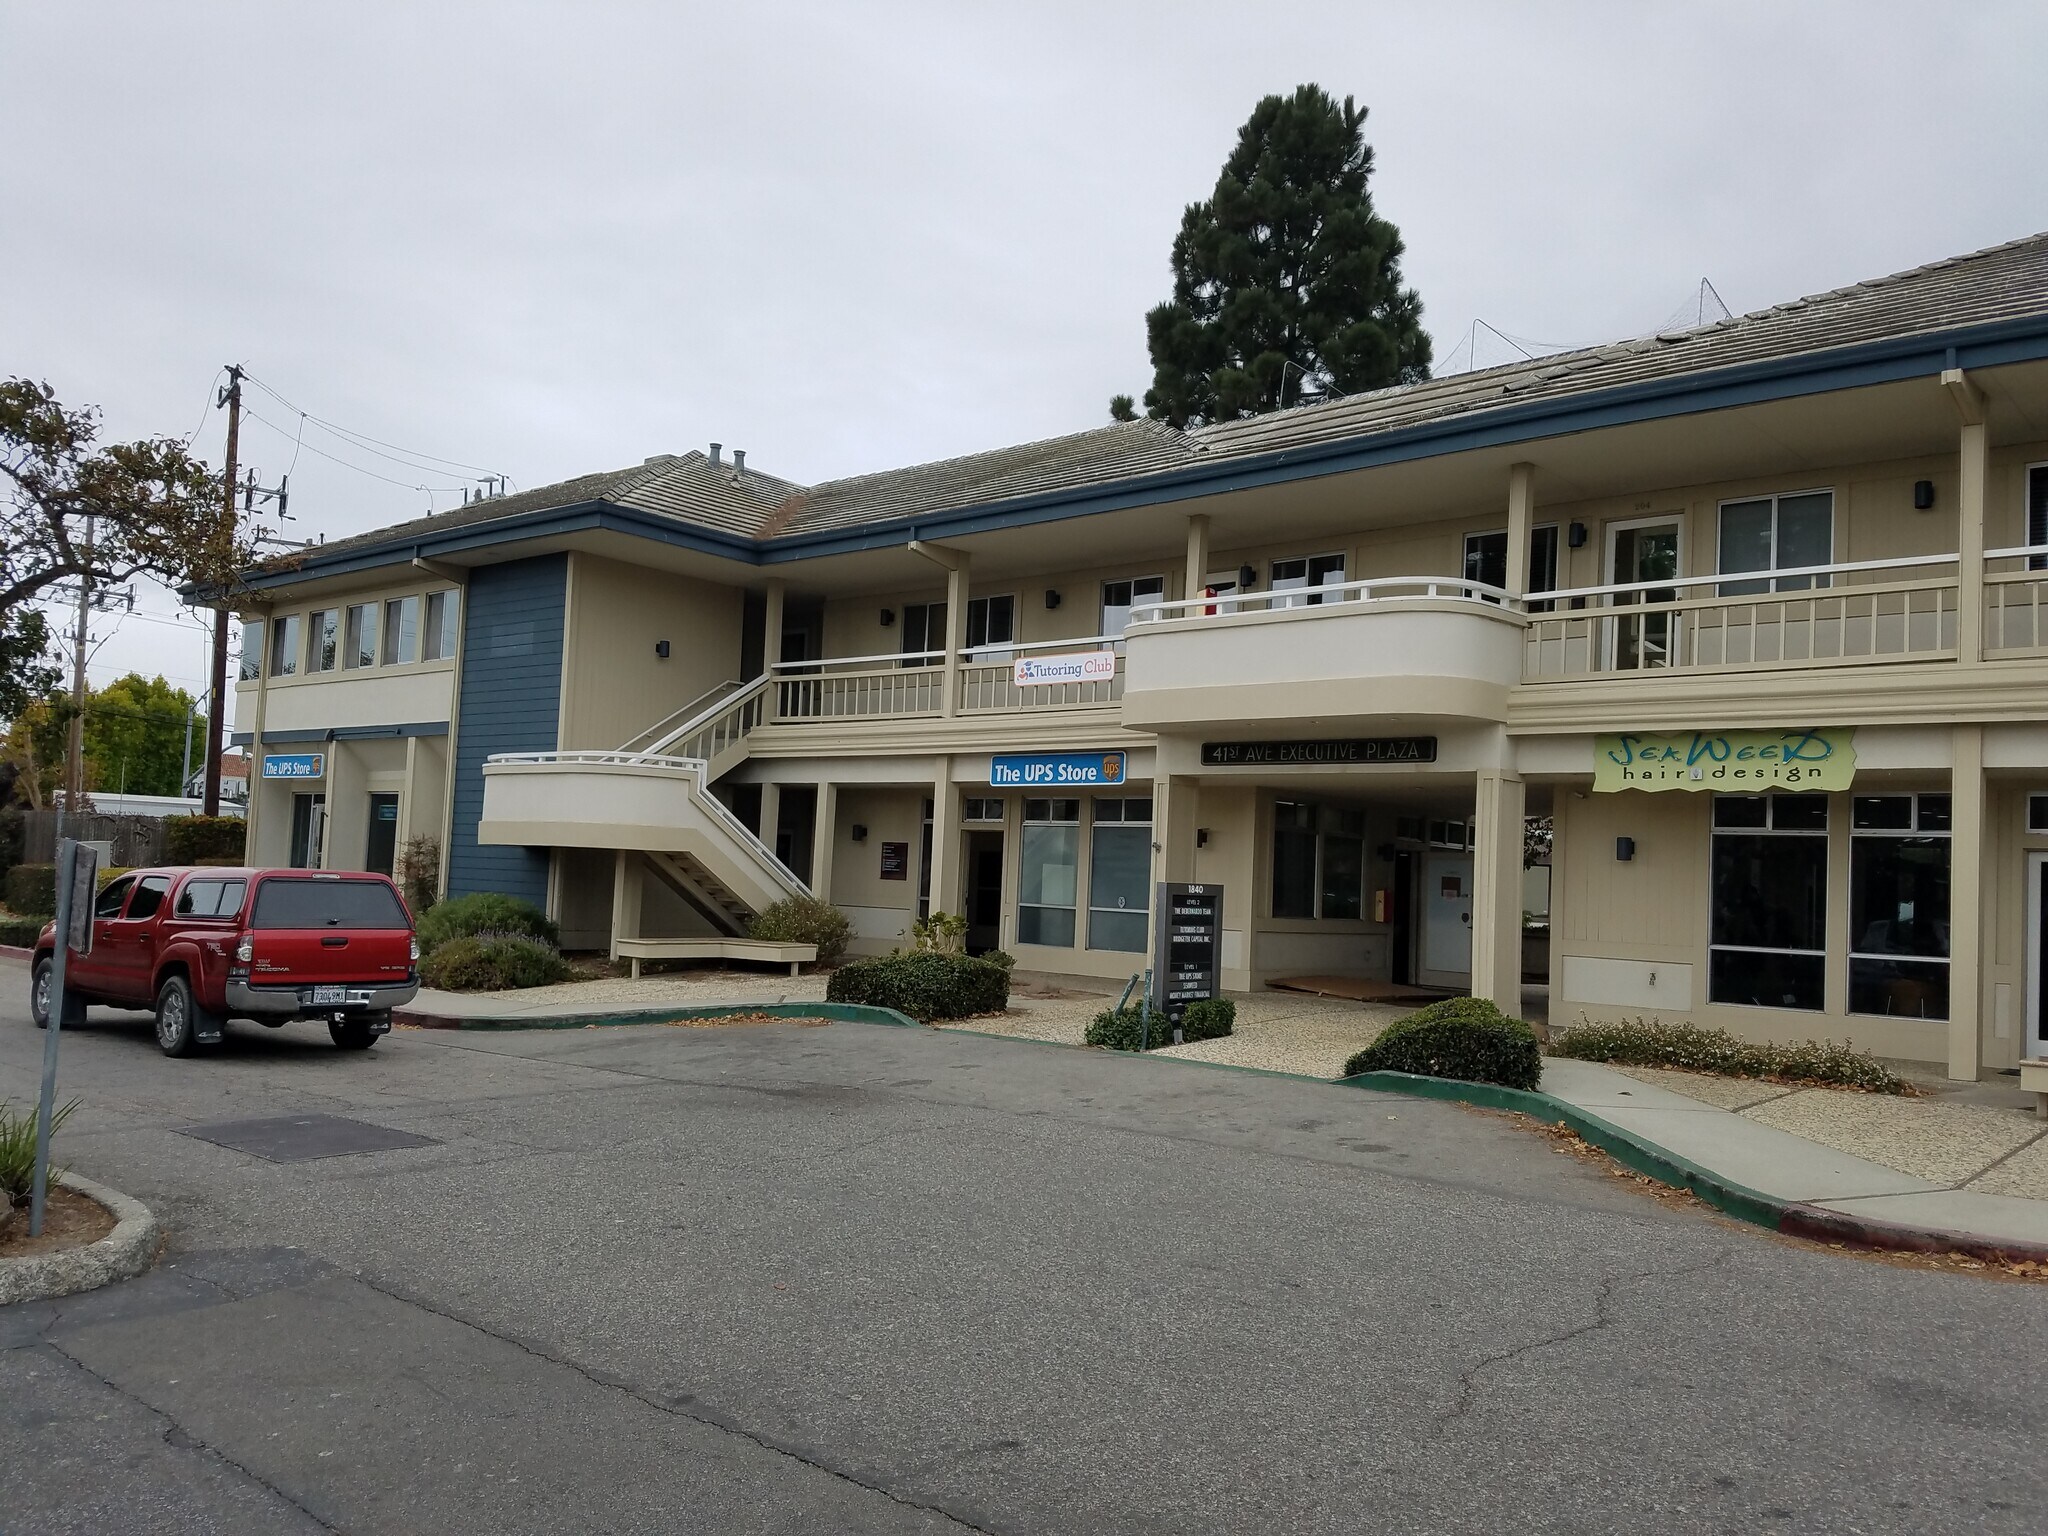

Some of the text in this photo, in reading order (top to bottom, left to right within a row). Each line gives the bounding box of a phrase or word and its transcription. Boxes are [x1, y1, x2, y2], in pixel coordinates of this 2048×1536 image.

[1034, 658, 1112, 678] Tutoring Club
[1246, 745, 1272, 760] AVE
[1280, 743, 1358, 760] EXECUTIVE
[1366, 742, 1419, 759] PLAZA
[265, 762, 278, 775] The
[278, 762, 292, 775] UPS
[292, 762, 311, 775] Store
[995, 763, 1097, 782] The UPS Store
[1104, 763, 1119, 777] ups
[1623, 765, 1822, 783] hair design
[1188, 885, 1204, 894] 1840
[1192, 972, 1203, 980] STORE
